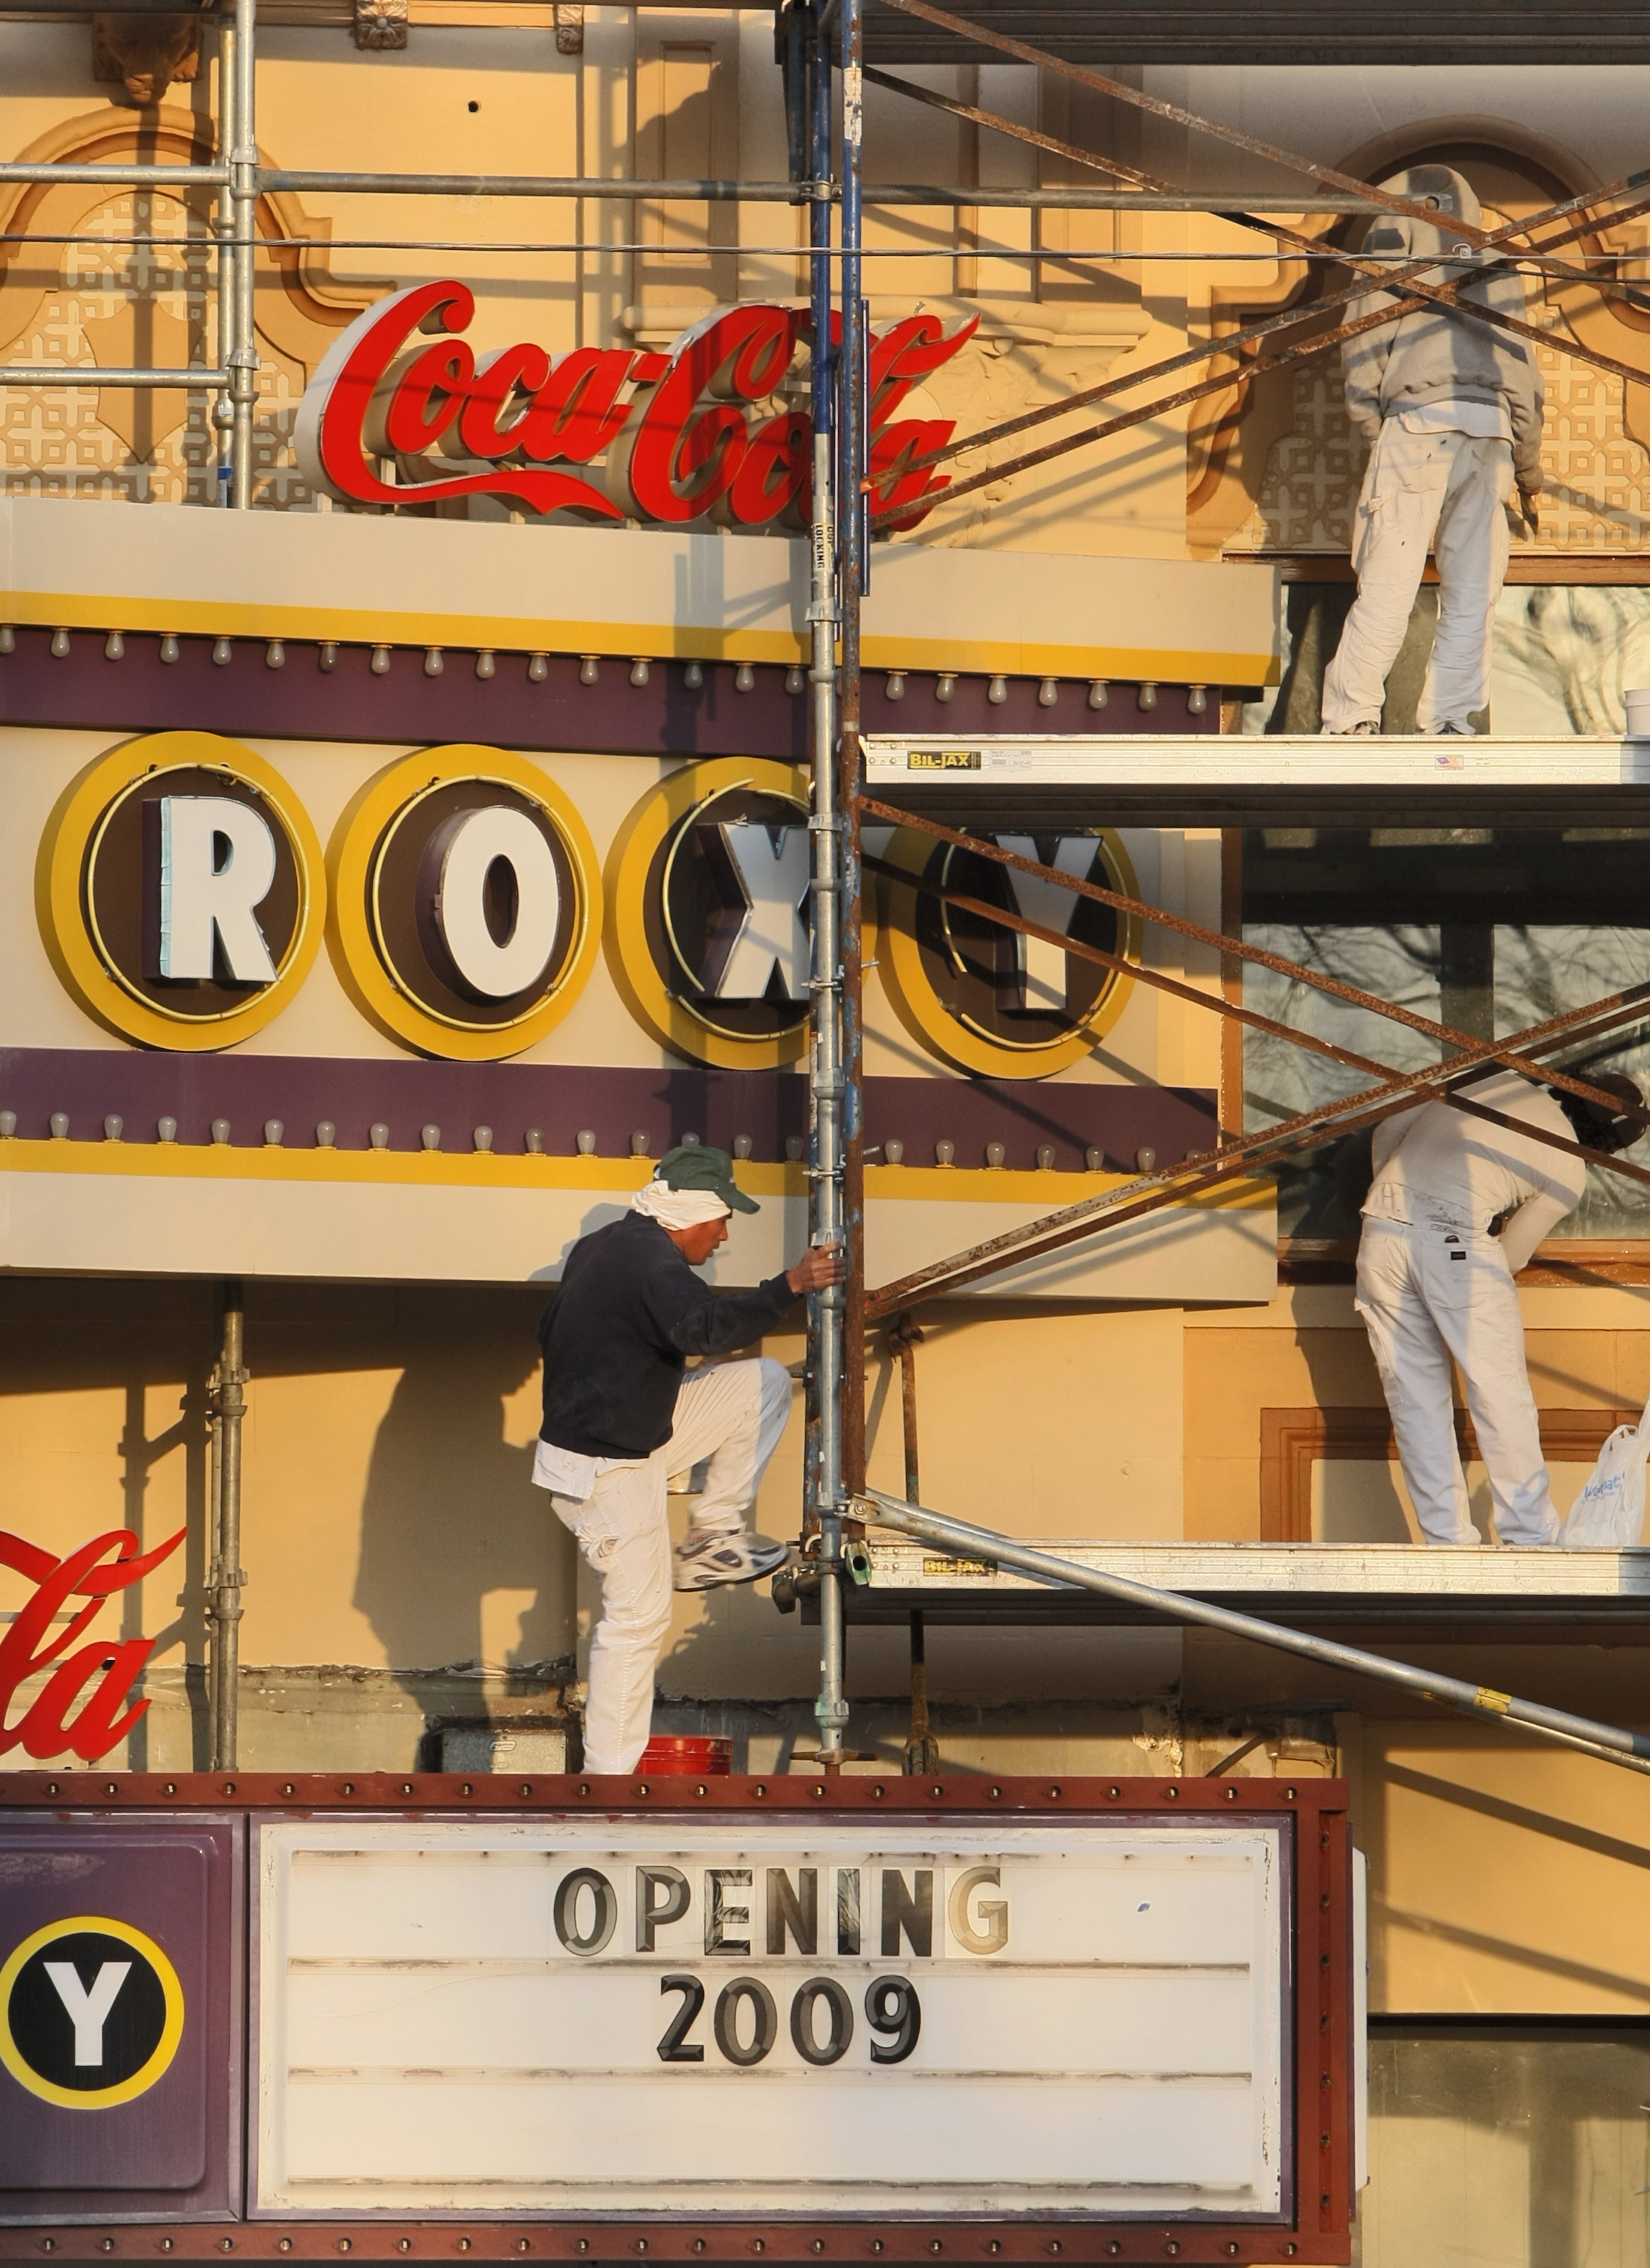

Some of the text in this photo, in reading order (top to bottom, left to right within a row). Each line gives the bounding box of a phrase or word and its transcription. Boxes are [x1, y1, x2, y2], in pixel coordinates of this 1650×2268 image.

[320, 279, 981, 533] Coca-Cola
[909, 752, 970, 769] BIL-JAX
[156, 796, 1103, 1009] ROXY
[553, 1866, 1008, 1957] OPENING
[43, 1962, 132, 2066] Y
[656, 1974, 922, 2066] 2009
